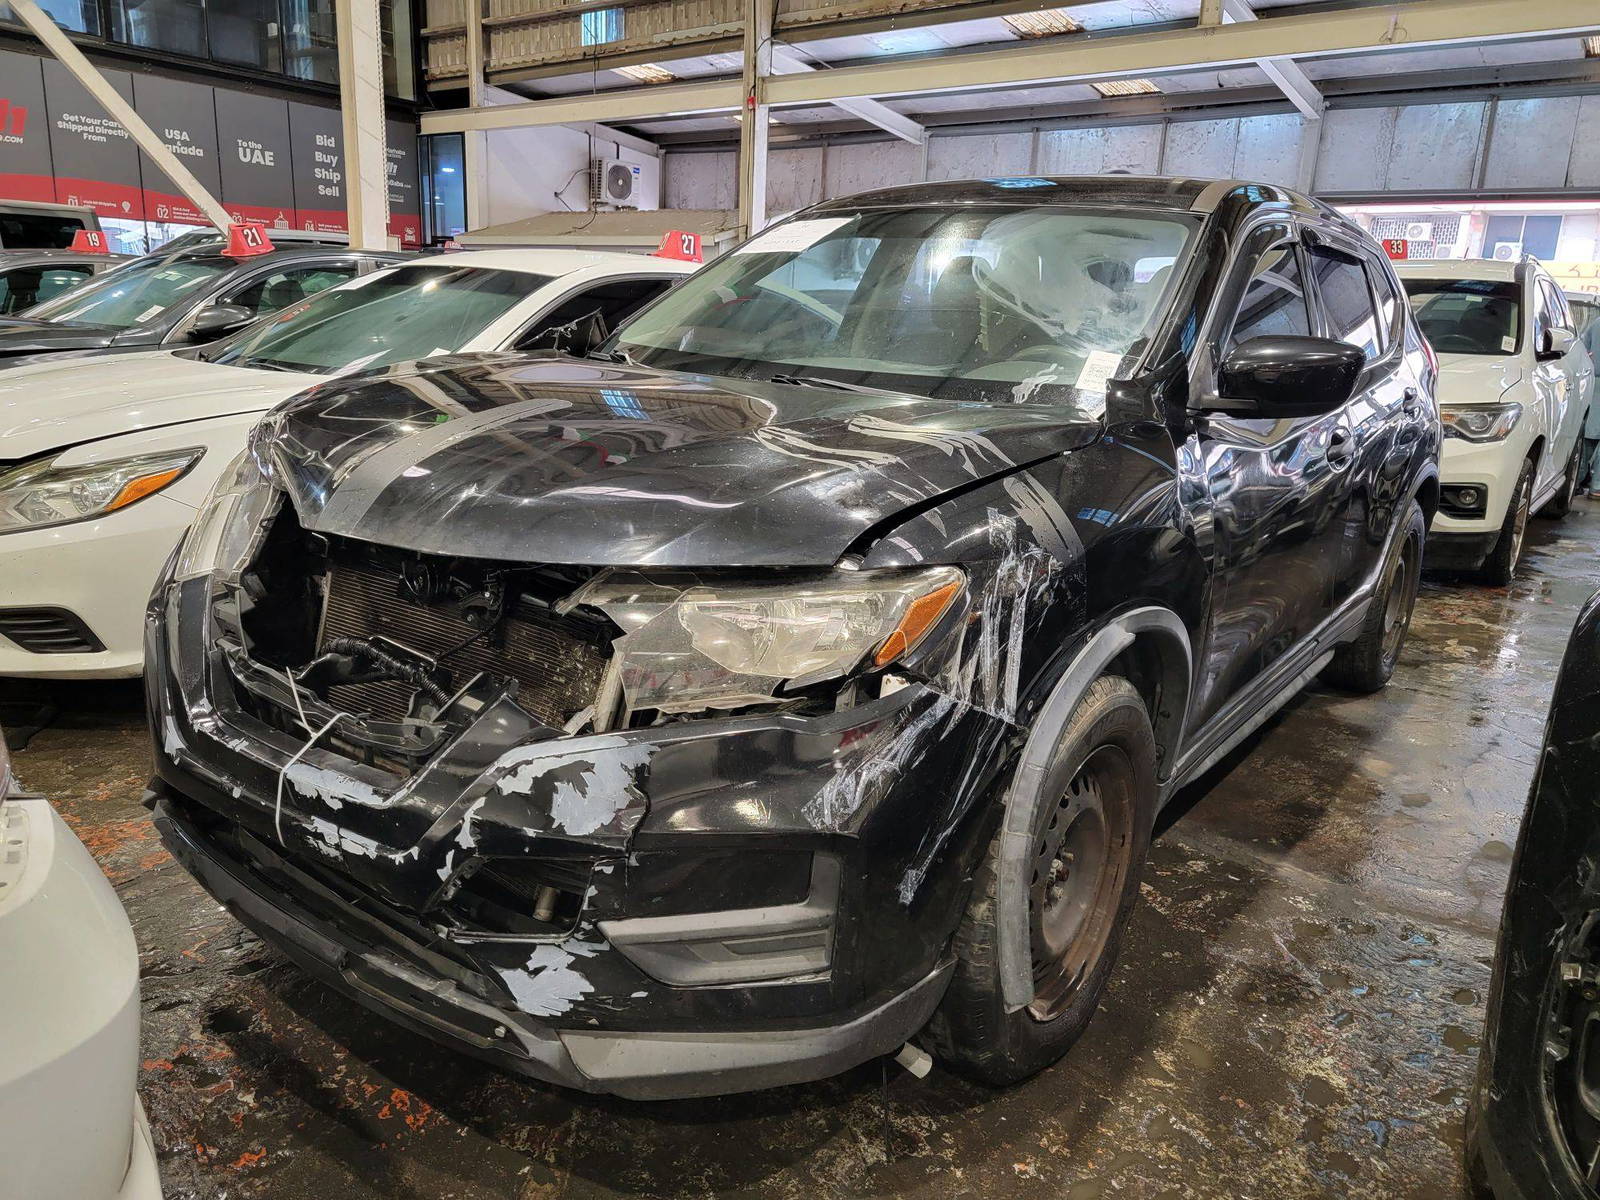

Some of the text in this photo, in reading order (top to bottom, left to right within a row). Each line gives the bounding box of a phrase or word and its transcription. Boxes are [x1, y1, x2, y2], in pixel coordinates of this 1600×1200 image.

[62, 113, 79, 122] Get
[80, 115, 101, 125] Your
[57, 120, 129, 139] Shipped Directly
[165, 128, 190, 142] USA
[83, 132, 107, 142] From
[236, 139, 262, 149] To the
[315, 134, 335, 148] Bid
[165, 143, 204, 157] anada
[238, 147, 275, 166] UAE
[314, 151, 338, 167] Buy
[314, 168, 341, 183] Ship
[318, 184, 340, 197] Sell
[157, 207, 169, 219] 02
[87, 232, 100, 247] 19
[243, 227, 262, 247] 21
[681, 234, 695, 255] 27
[1391, 240, 1403, 254] 33
